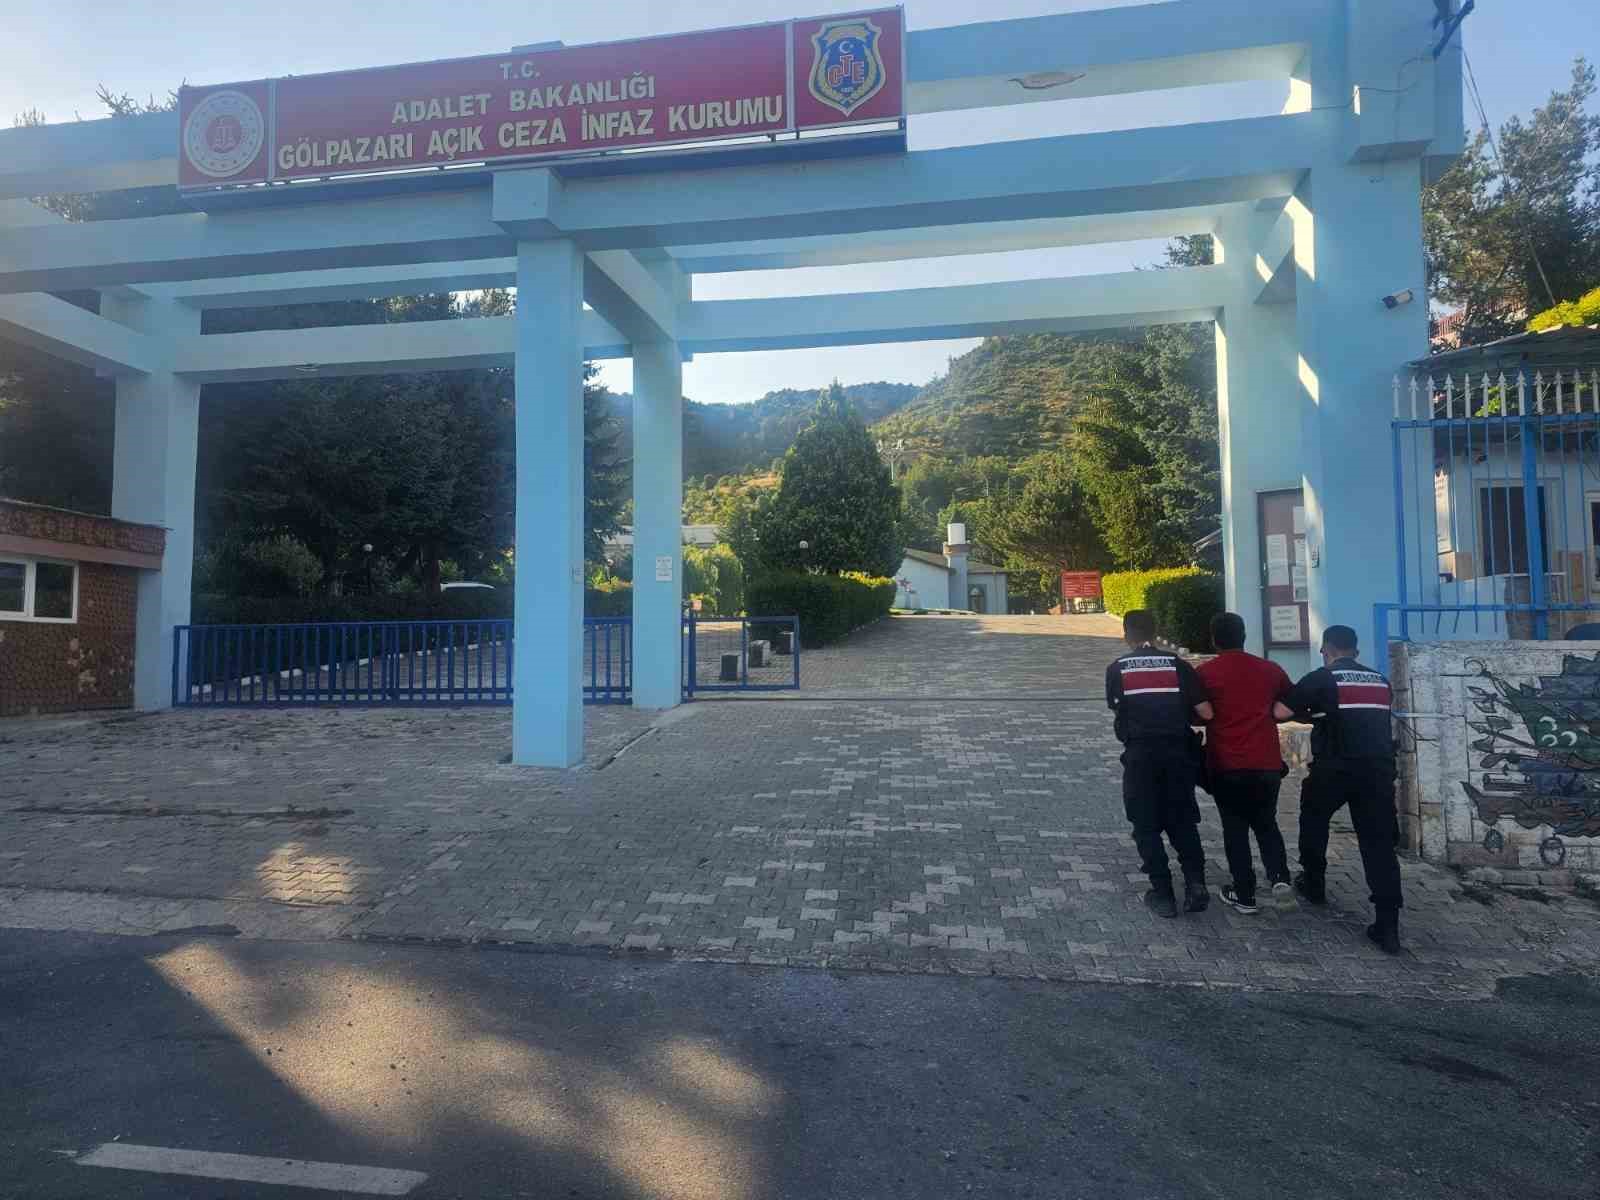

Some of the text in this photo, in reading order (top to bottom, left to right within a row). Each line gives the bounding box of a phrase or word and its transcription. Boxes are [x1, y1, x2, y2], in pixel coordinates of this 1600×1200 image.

[499, 61, 541, 81] T.C.
[392, 72, 656, 124] ADALET BAKANLIĞI
[277, 95, 783, 170] GÖLPAZARI AÇIK CEZA İNFAZ KURUMU
